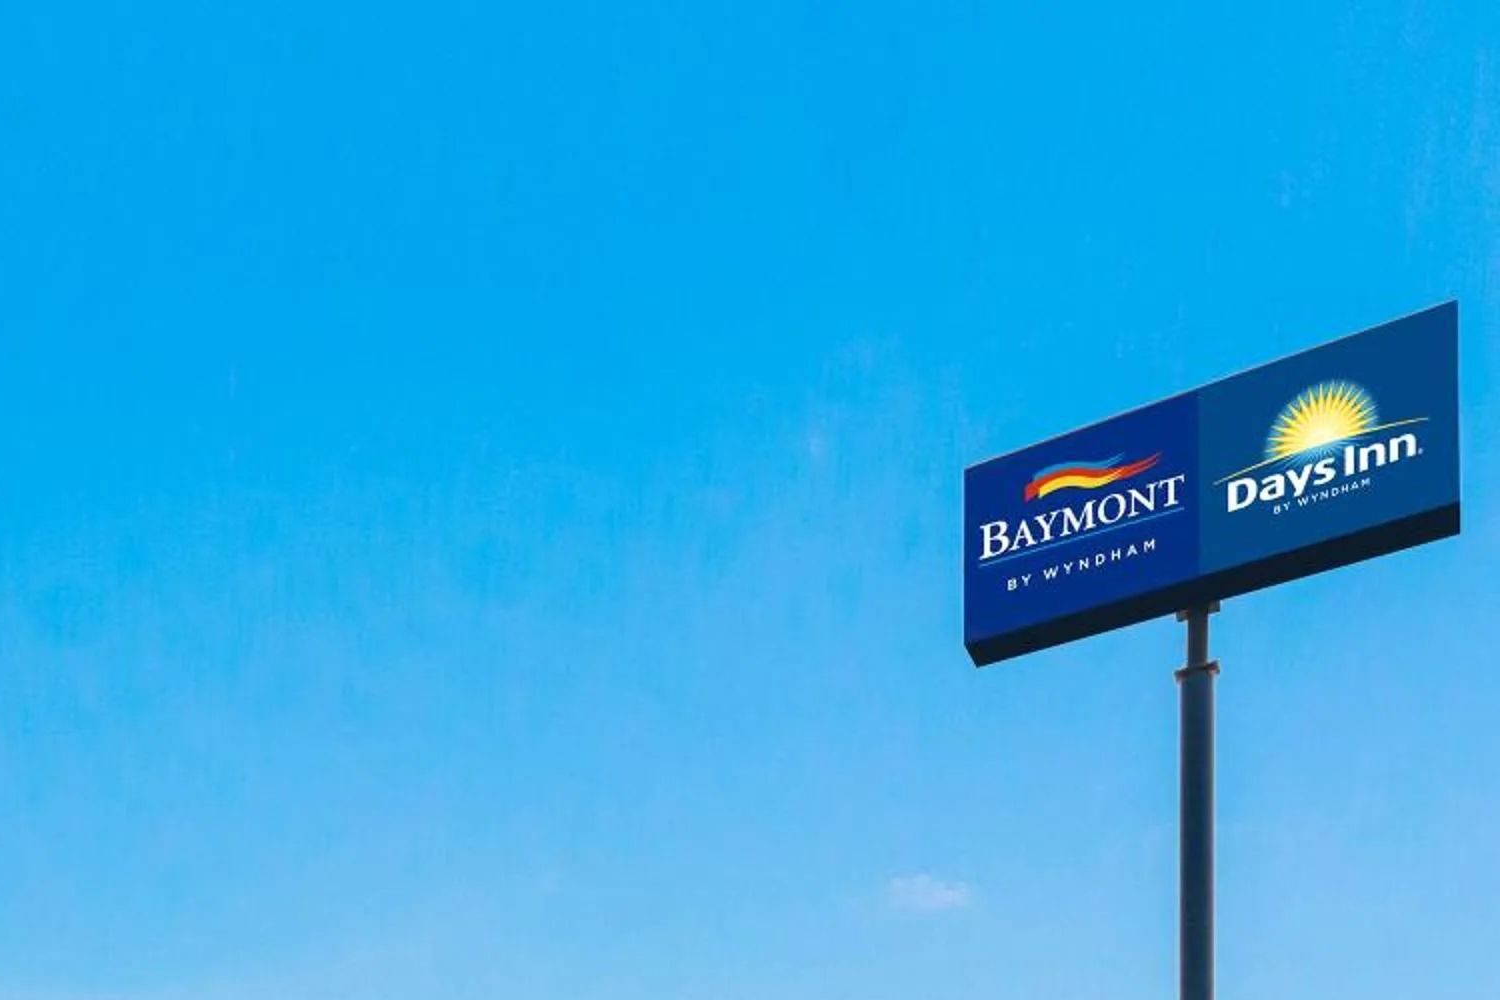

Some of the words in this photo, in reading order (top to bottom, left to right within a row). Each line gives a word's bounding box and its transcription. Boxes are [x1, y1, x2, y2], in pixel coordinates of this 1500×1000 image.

[1227, 457, 1336, 512] Days
[1344, 433, 1417, 476] Inn
[1273, 502, 1291, 515] BY
[1297, 478, 1371, 507] WYNDHAM
[979, 474, 1185, 560] BAYMONT
[1007, 574, 1032, 591] BY
[1043, 538, 1156, 580] WYNDHAM
